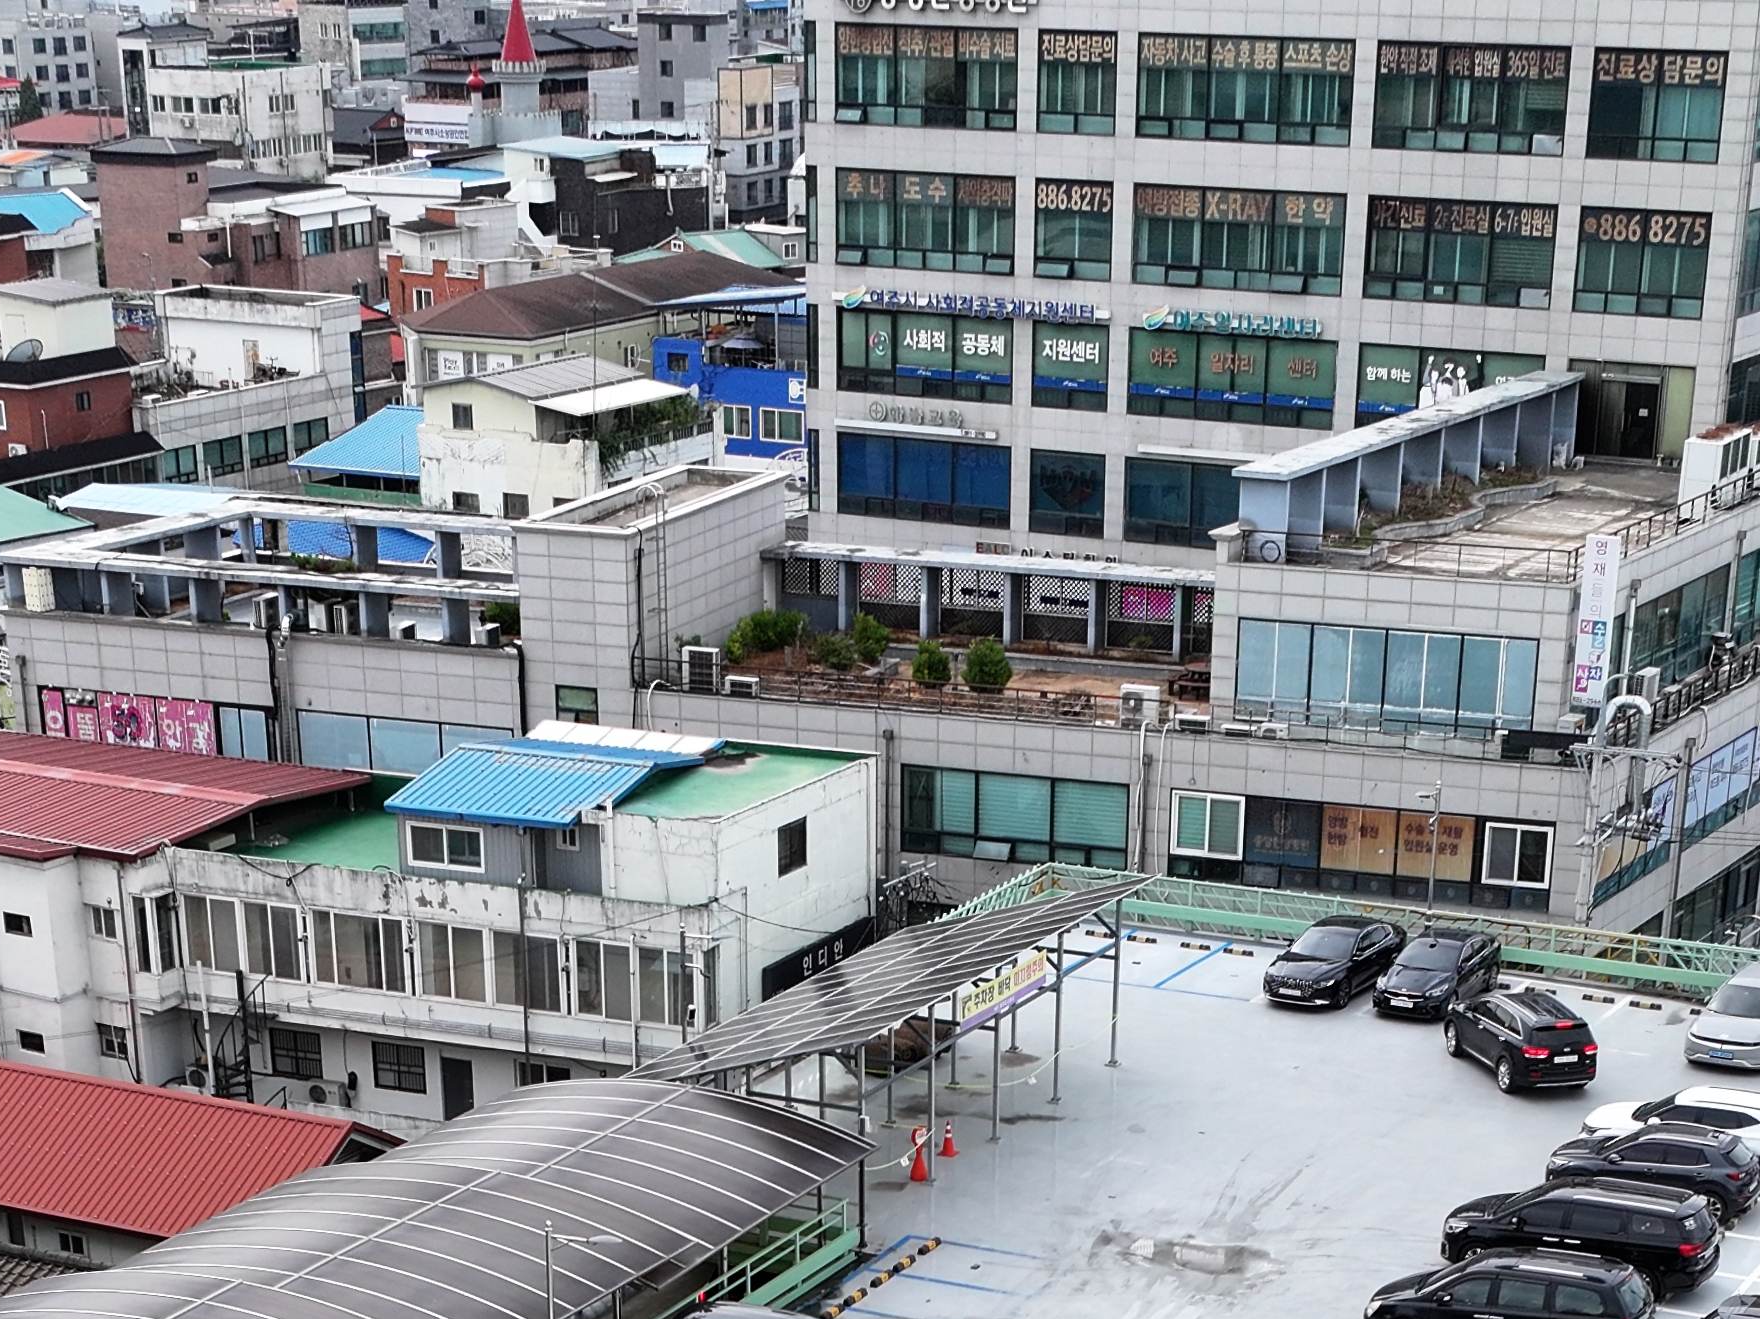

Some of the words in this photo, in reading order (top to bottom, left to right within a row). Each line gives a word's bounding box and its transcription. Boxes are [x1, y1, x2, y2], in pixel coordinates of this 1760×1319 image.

[1042, 34, 1115, 63] 진료상담문의
[1141, 38, 1178, 66] 자동차
[1182, 38, 1206, 65] 사고
[1212, 41, 1235, 67] 수술
[1253, 42, 1278, 69] 통증
[1284, 43, 1322, 67] 스포츠
[1326, 43, 1352, 72] 손상
[1473, 48, 1501, 77] 입원실
[1507, 50, 1539, 78] 365일
[1543, 50, 1565, 79] 진료
[1205, 192, 1270, 221] X-RAY
[1450, 205, 1489, 233] 진료실
[1521, 209, 1554, 238] 입원실
[870, 290, 918, 310] 여주시
[903, 329, 946, 352] 사회적
[962, 334, 1004, 357] 공동체
[1043, 339, 1099, 364] 지원센터
[1150, 347, 1178, 366] 여주
[1210, 353, 1254, 375] 일자리
[1288, 358, 1316, 379] 센터
[1367, 367, 1387, 382] 함께
[1391, 368, 1411, 383] 하는
[974, 985, 994, 1009] 주차장
